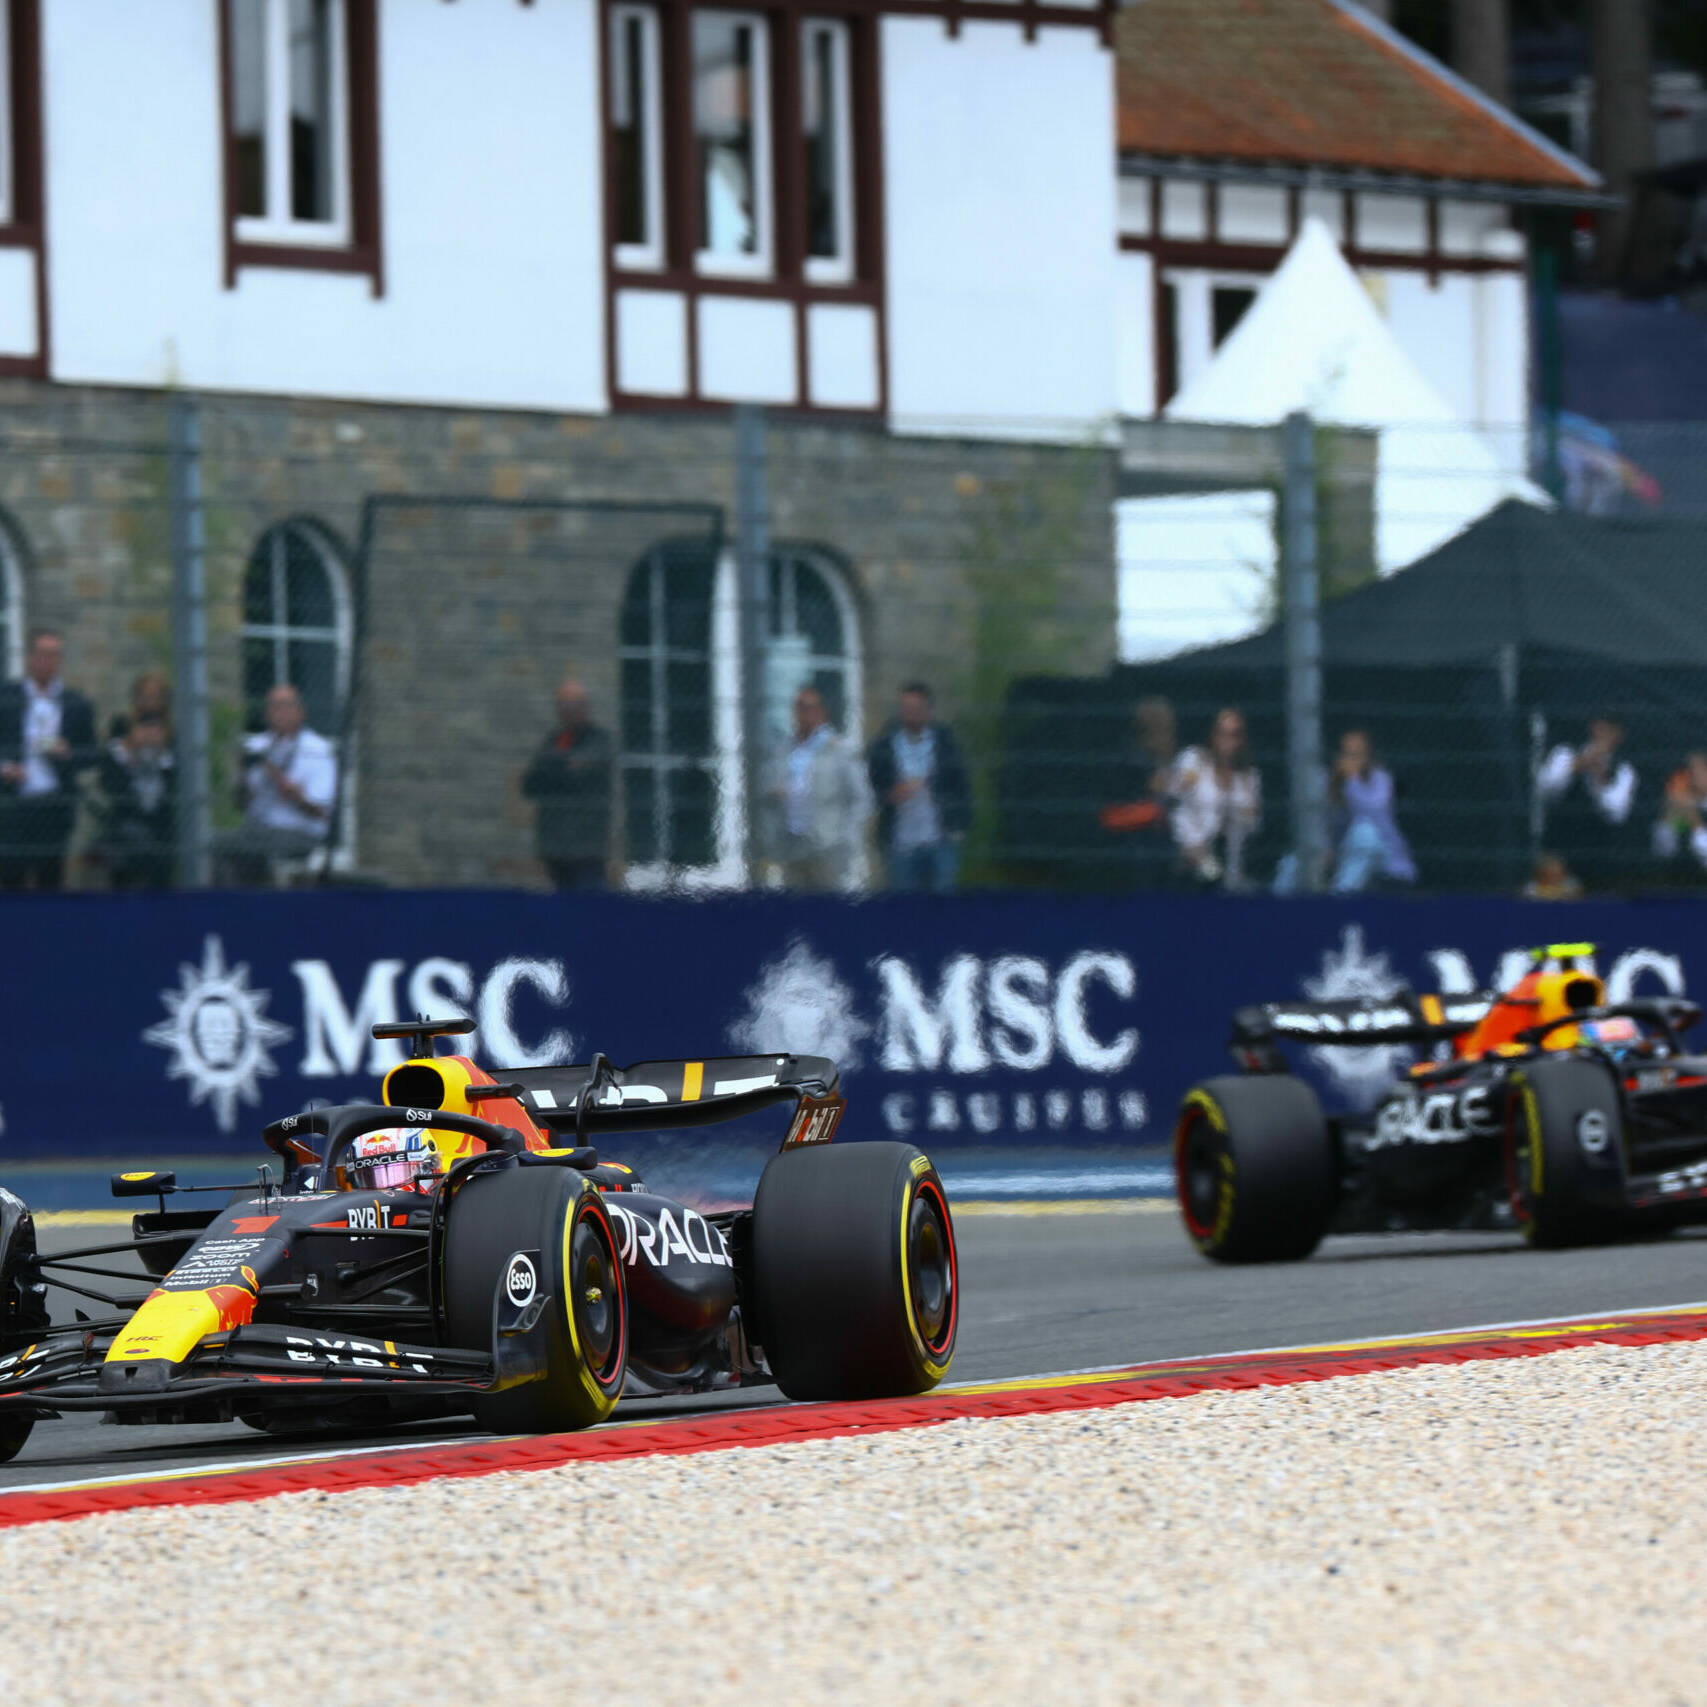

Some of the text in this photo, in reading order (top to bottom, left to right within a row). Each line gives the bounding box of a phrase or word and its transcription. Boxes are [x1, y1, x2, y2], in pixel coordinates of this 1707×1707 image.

[292, 957, 573, 1077] MSC
[878, 953, 1138, 1072] MSC
[355, 1153, 407, 1169] ORACLE
[362, 1144, 397, 1157] Red Bull
